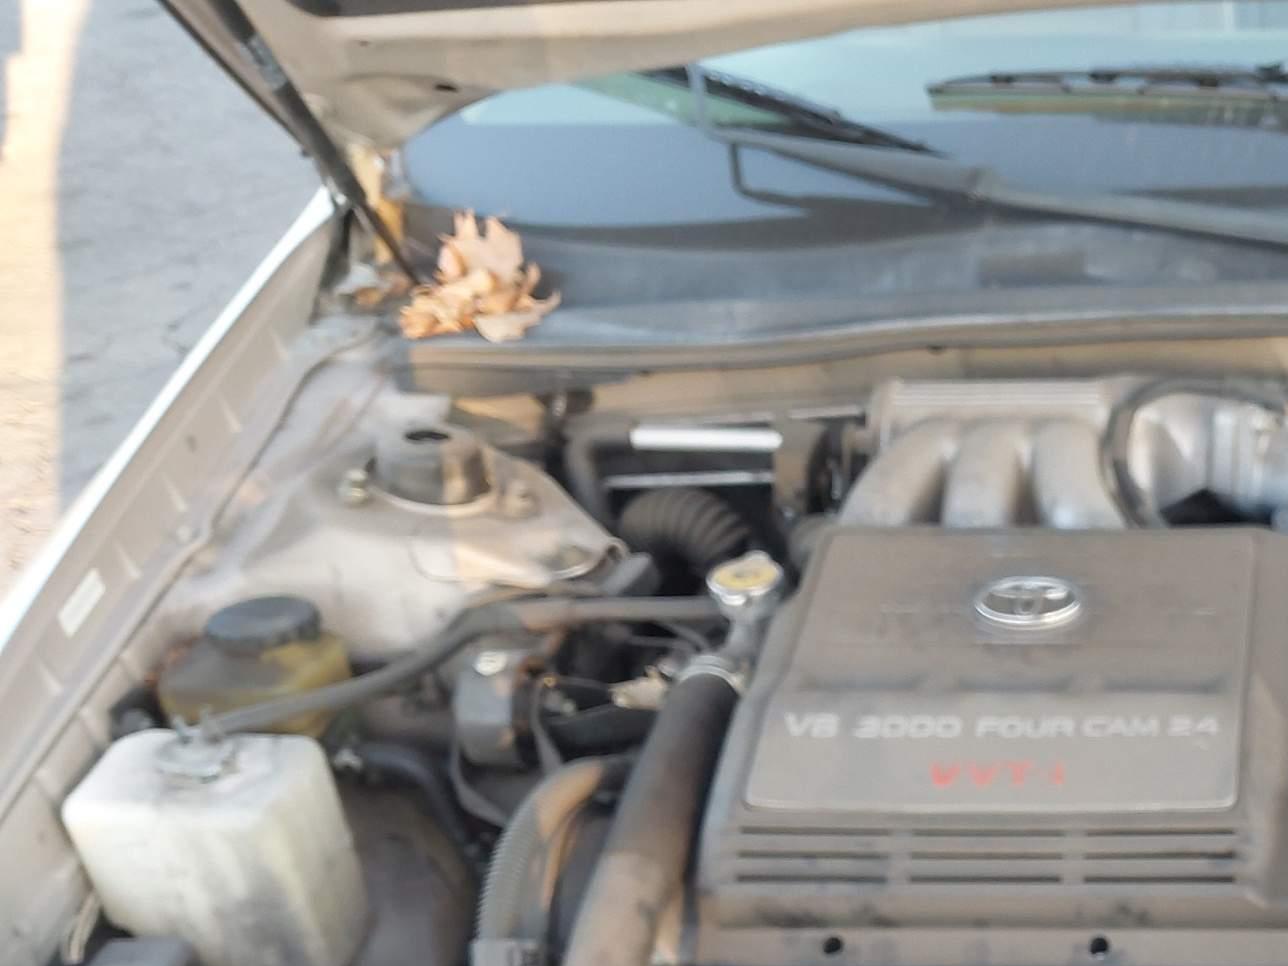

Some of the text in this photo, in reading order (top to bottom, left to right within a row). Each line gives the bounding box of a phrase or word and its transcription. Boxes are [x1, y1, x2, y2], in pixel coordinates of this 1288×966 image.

[853, 714, 963, 738] 3000
[975, 715, 1076, 738] FOUR
[1080, 715, 1160, 737] CAM
[1167, 714, 1219, 737] 24
